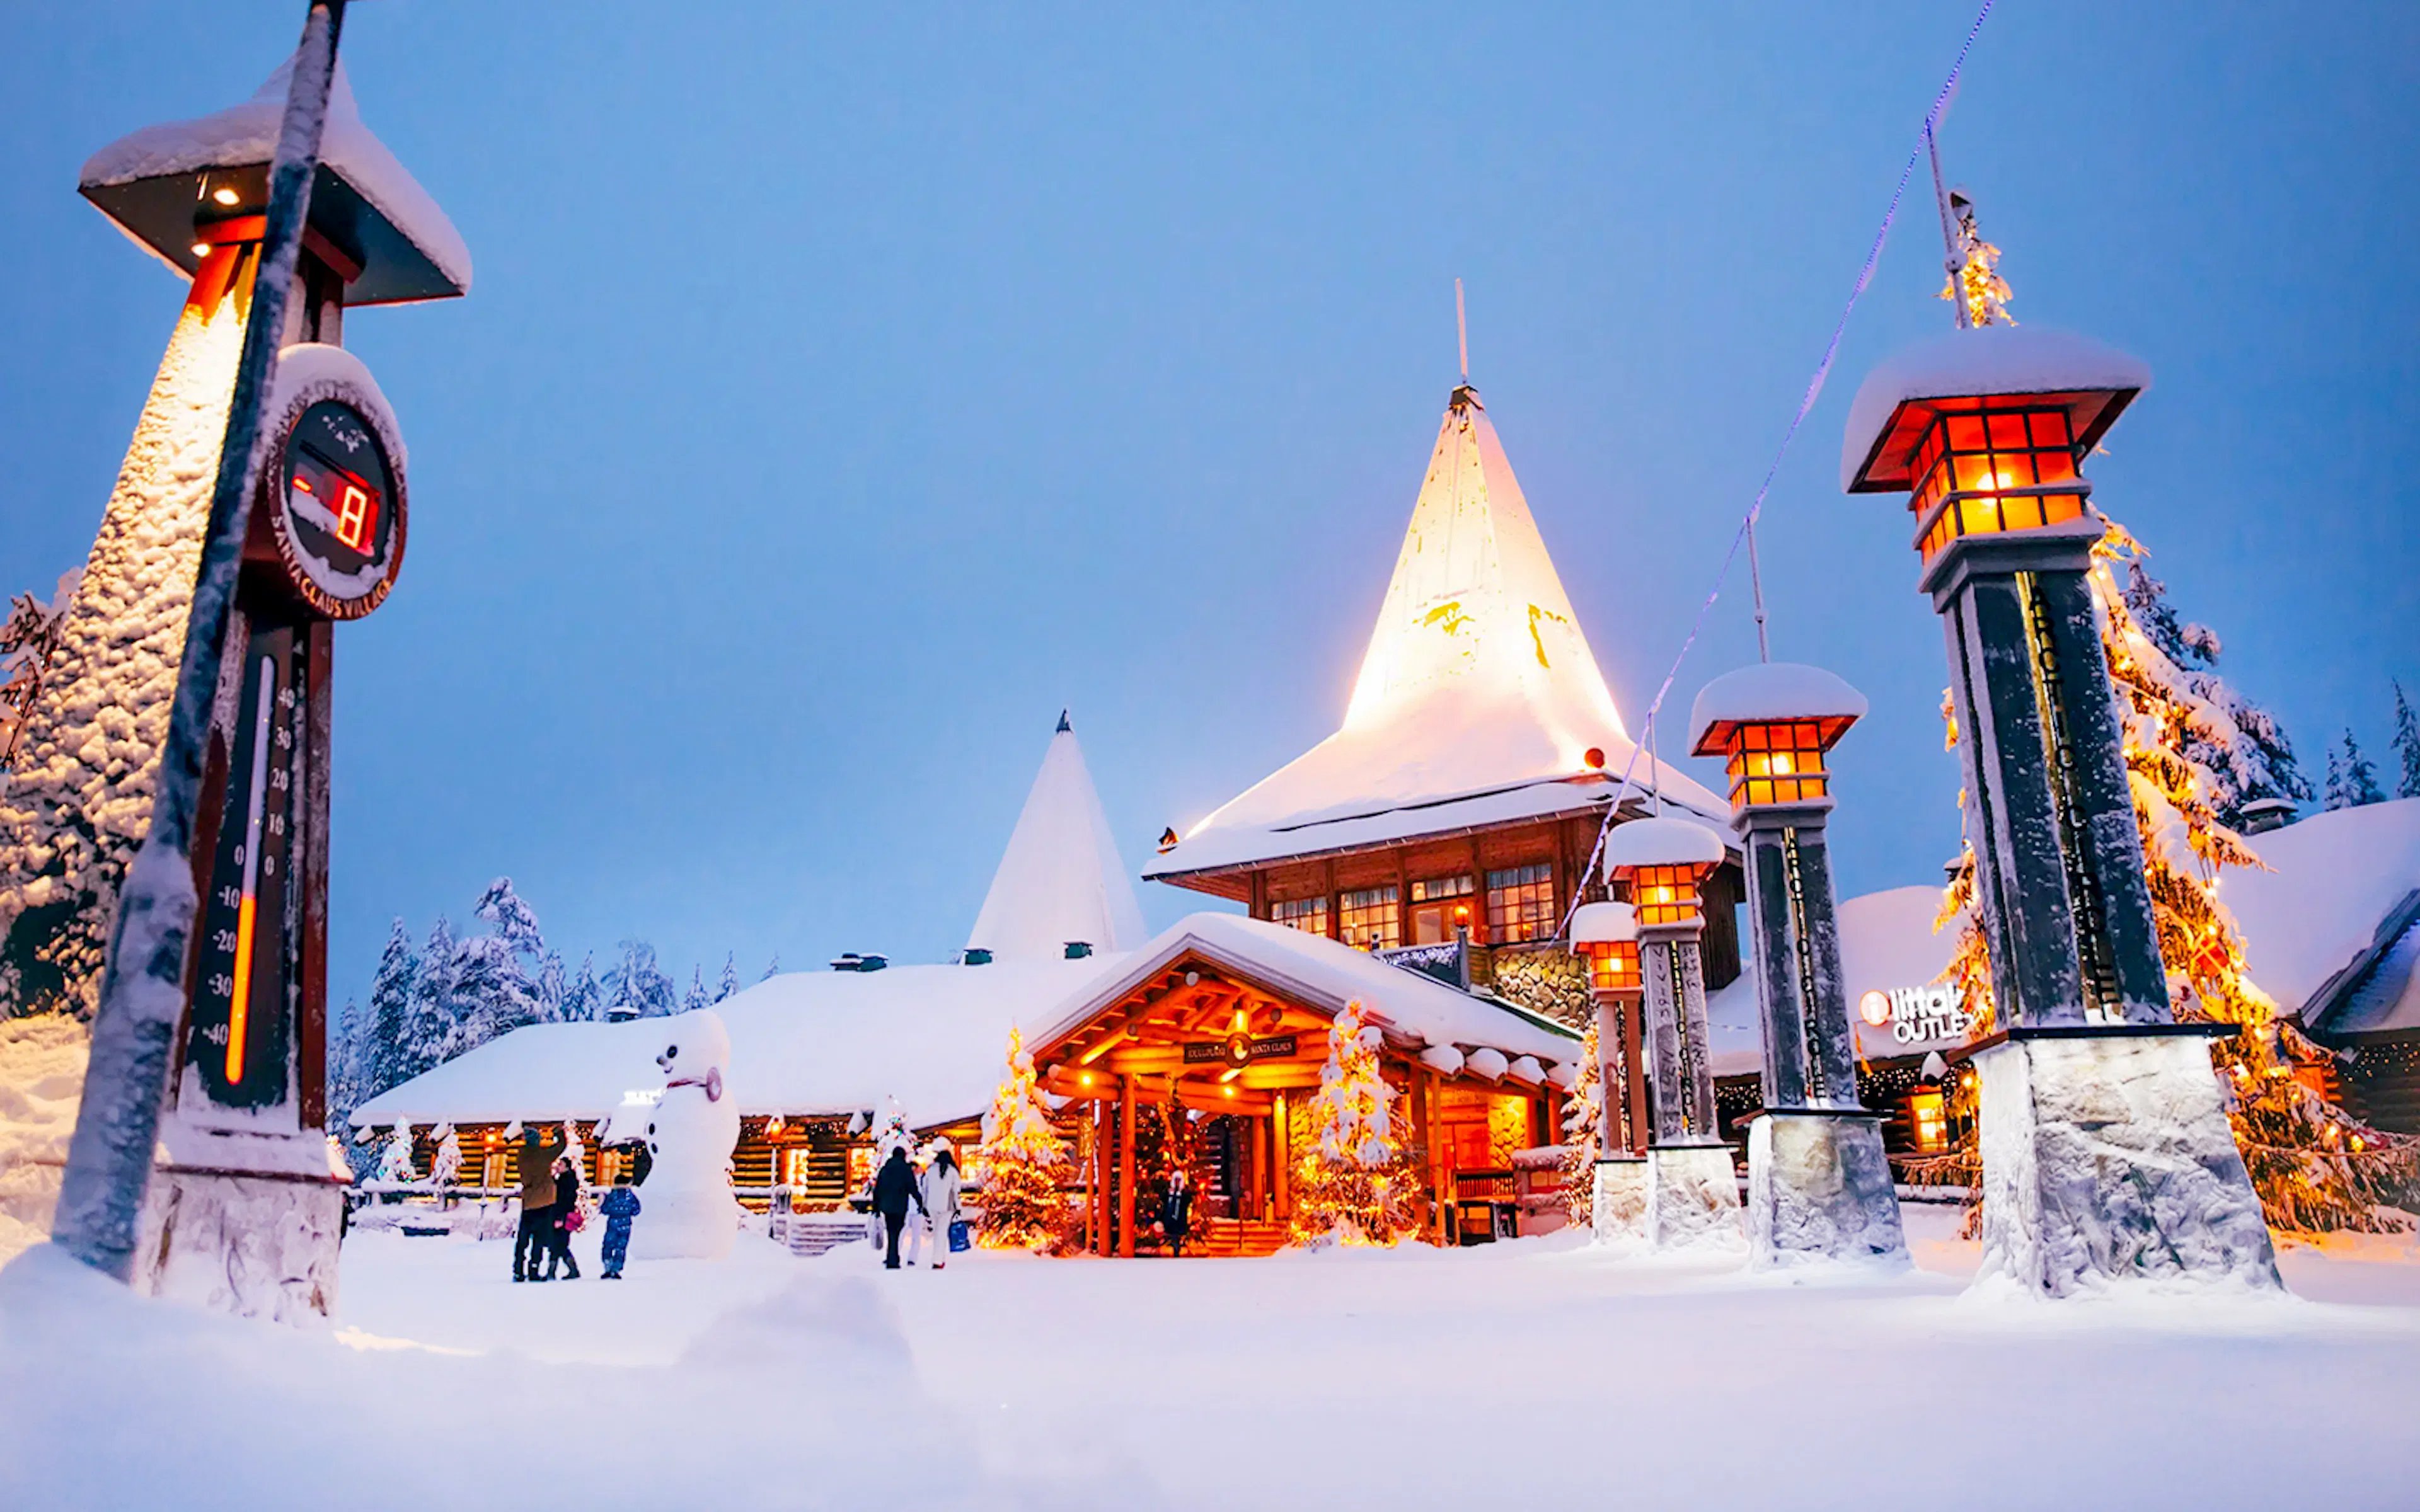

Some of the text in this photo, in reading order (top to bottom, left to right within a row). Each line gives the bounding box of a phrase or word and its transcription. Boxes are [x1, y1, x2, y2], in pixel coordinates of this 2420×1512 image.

[271, 516, 392, 617] SANTA CLAUS VILLAGE
[278, 687, 296, 709] 40
[275, 726, 292, 750] 30
[271, 767, 289, 791] 20
[268, 813, 285, 835] 10
[234, 845, 245, 866] 0
[264, 855, 275, 876] 0
[218, 886, 241, 910] -10
[1788, 837, 1811, 956] ARCTIC
[212, 929, 236, 953] -20
[208, 973, 233, 997] -30
[202, 1022, 229, 1046] -40
